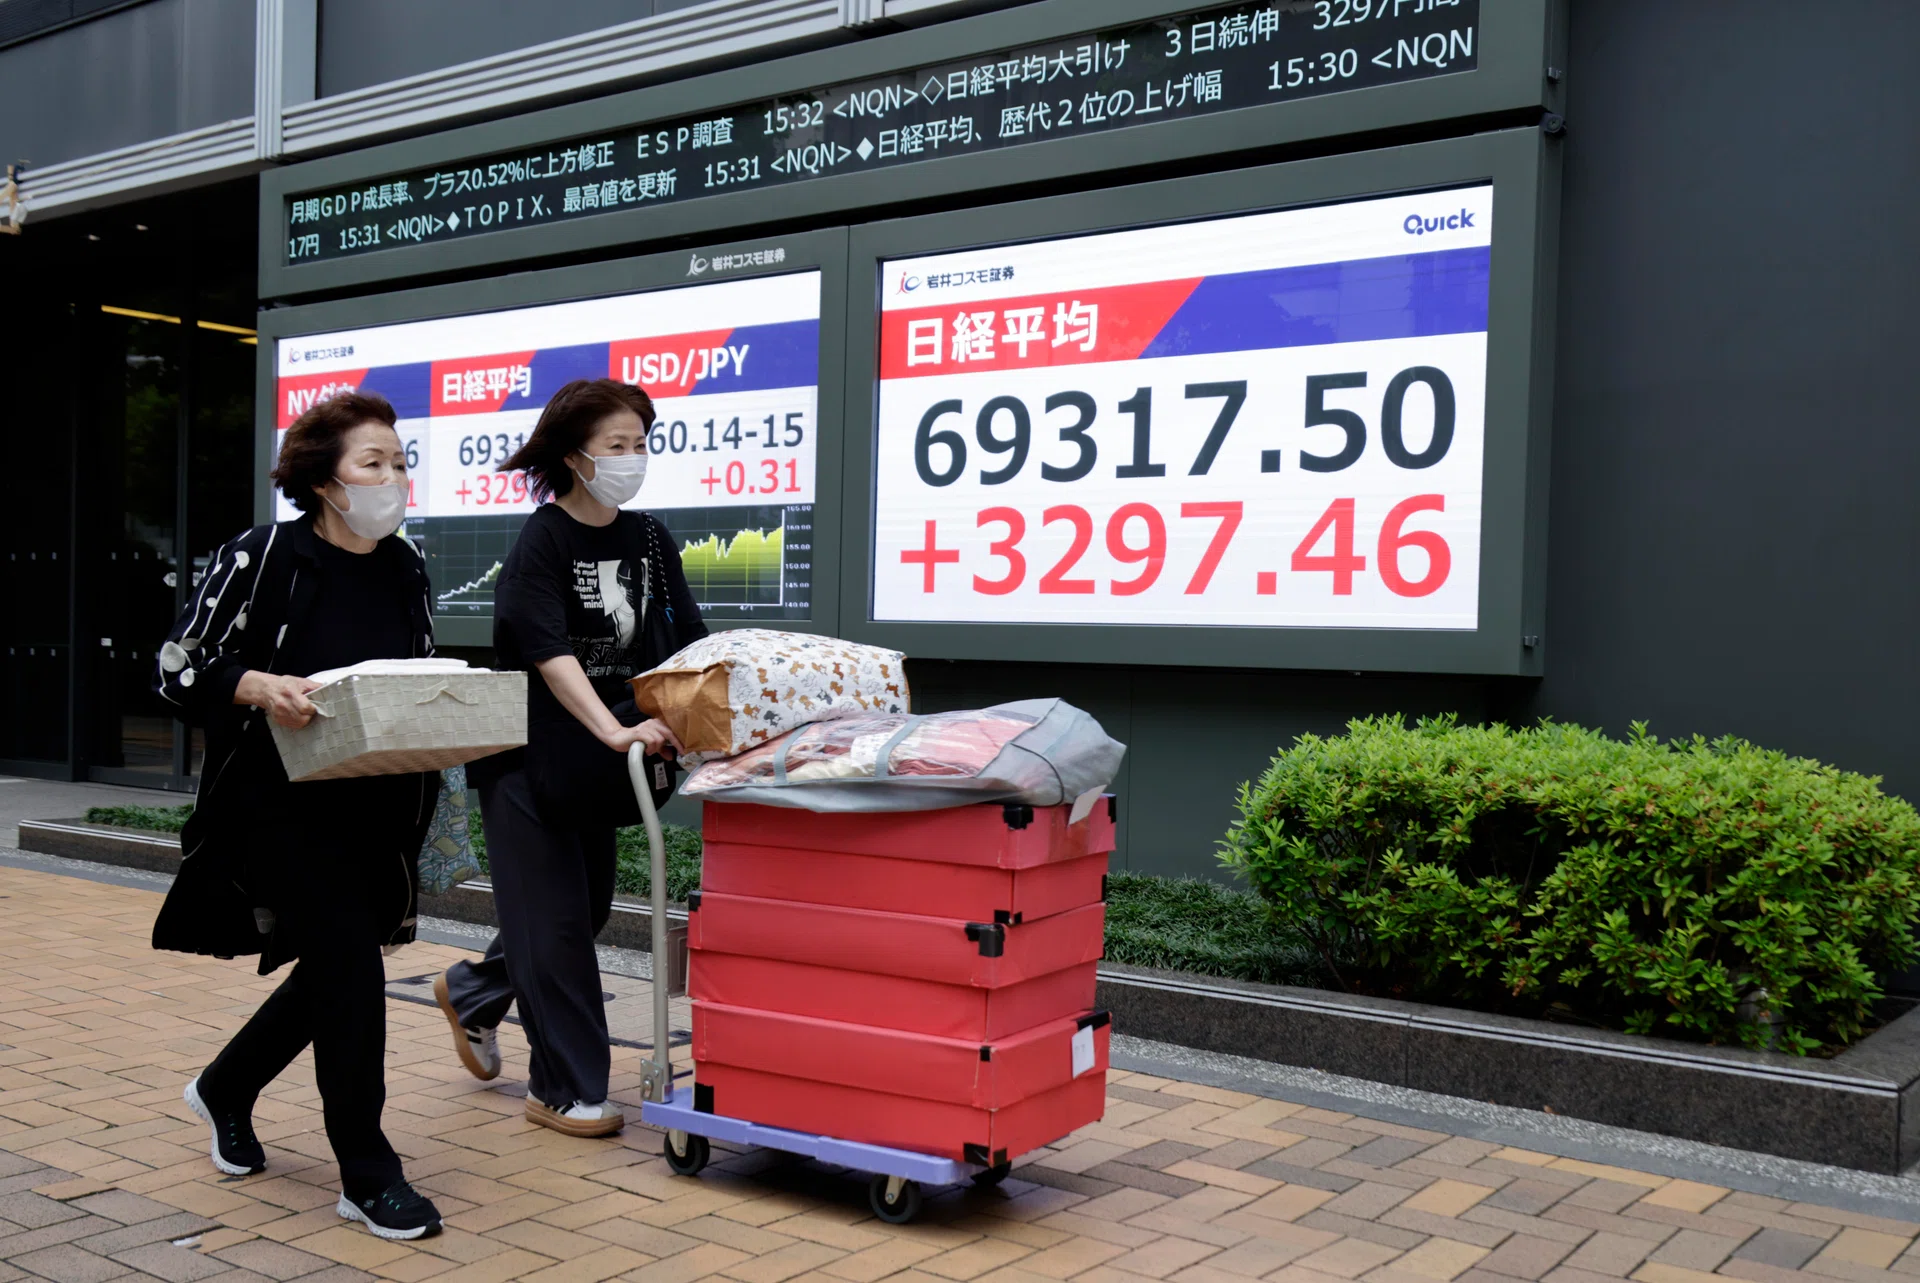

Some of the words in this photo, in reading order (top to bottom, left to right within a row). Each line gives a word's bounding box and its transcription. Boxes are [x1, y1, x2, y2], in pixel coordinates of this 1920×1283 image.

[763, 100, 824, 135] 15:32
[1165, 7, 1280, 57] 3日続伸
[289, 233, 320, 259] 17円
[340, 223, 381, 250] 15:31
[704, 155, 761, 188] 15:31
[1268, 48, 1358, 90] 15:30
[711, 247, 785, 271] 岩井コスモ証券
[926, 265, 1015, 289] 岩井コスモ証券
[907, 300, 1099, 367] 日経平均
[442, 364, 532, 404] 日経平均
[622, 344, 749, 387] USD/JPY
[914, 366, 1456, 488] 69317.50
[700, 458, 801, 496] +0.31
[900, 493, 1452, 598] +3297.46
